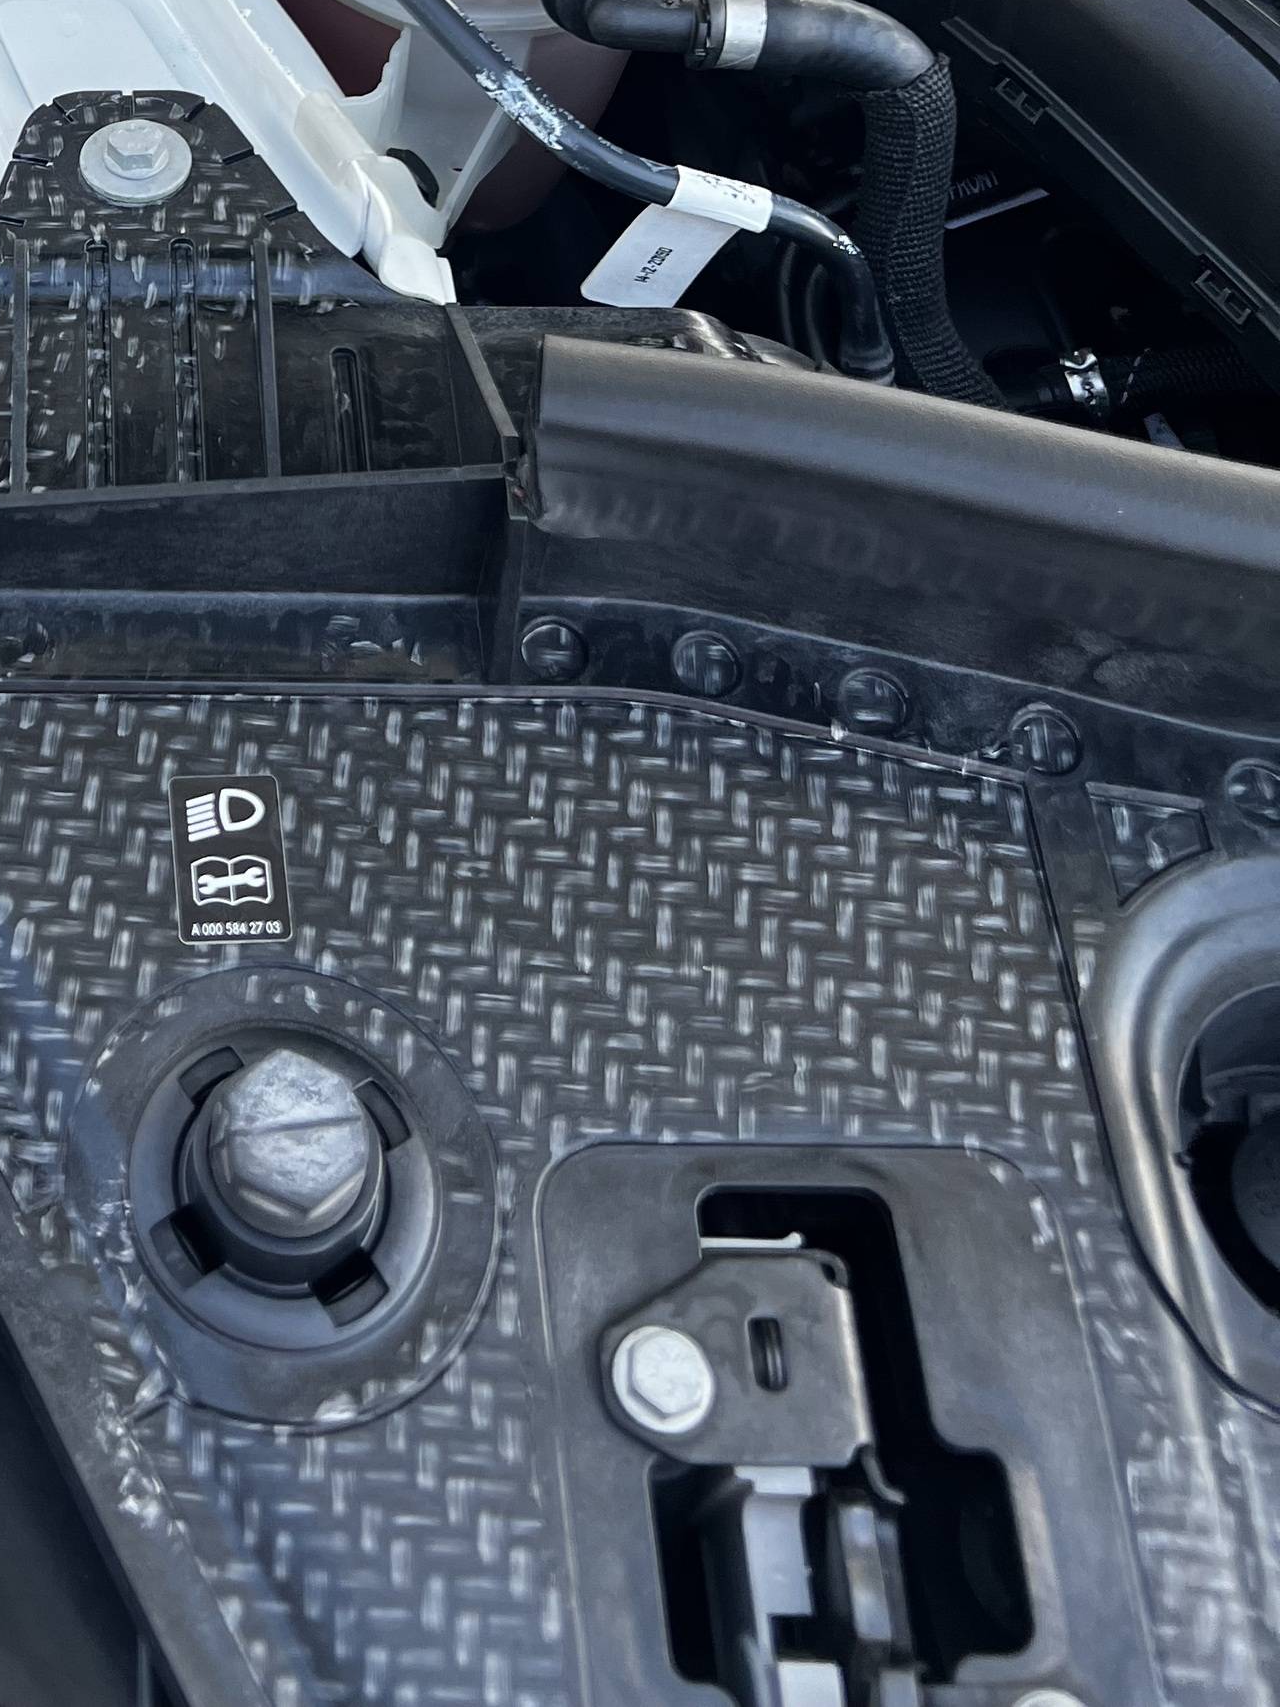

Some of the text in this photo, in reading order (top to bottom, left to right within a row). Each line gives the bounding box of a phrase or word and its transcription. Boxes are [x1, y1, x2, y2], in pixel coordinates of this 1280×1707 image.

[191, 920, 282, 936] A 000 584 27 03
